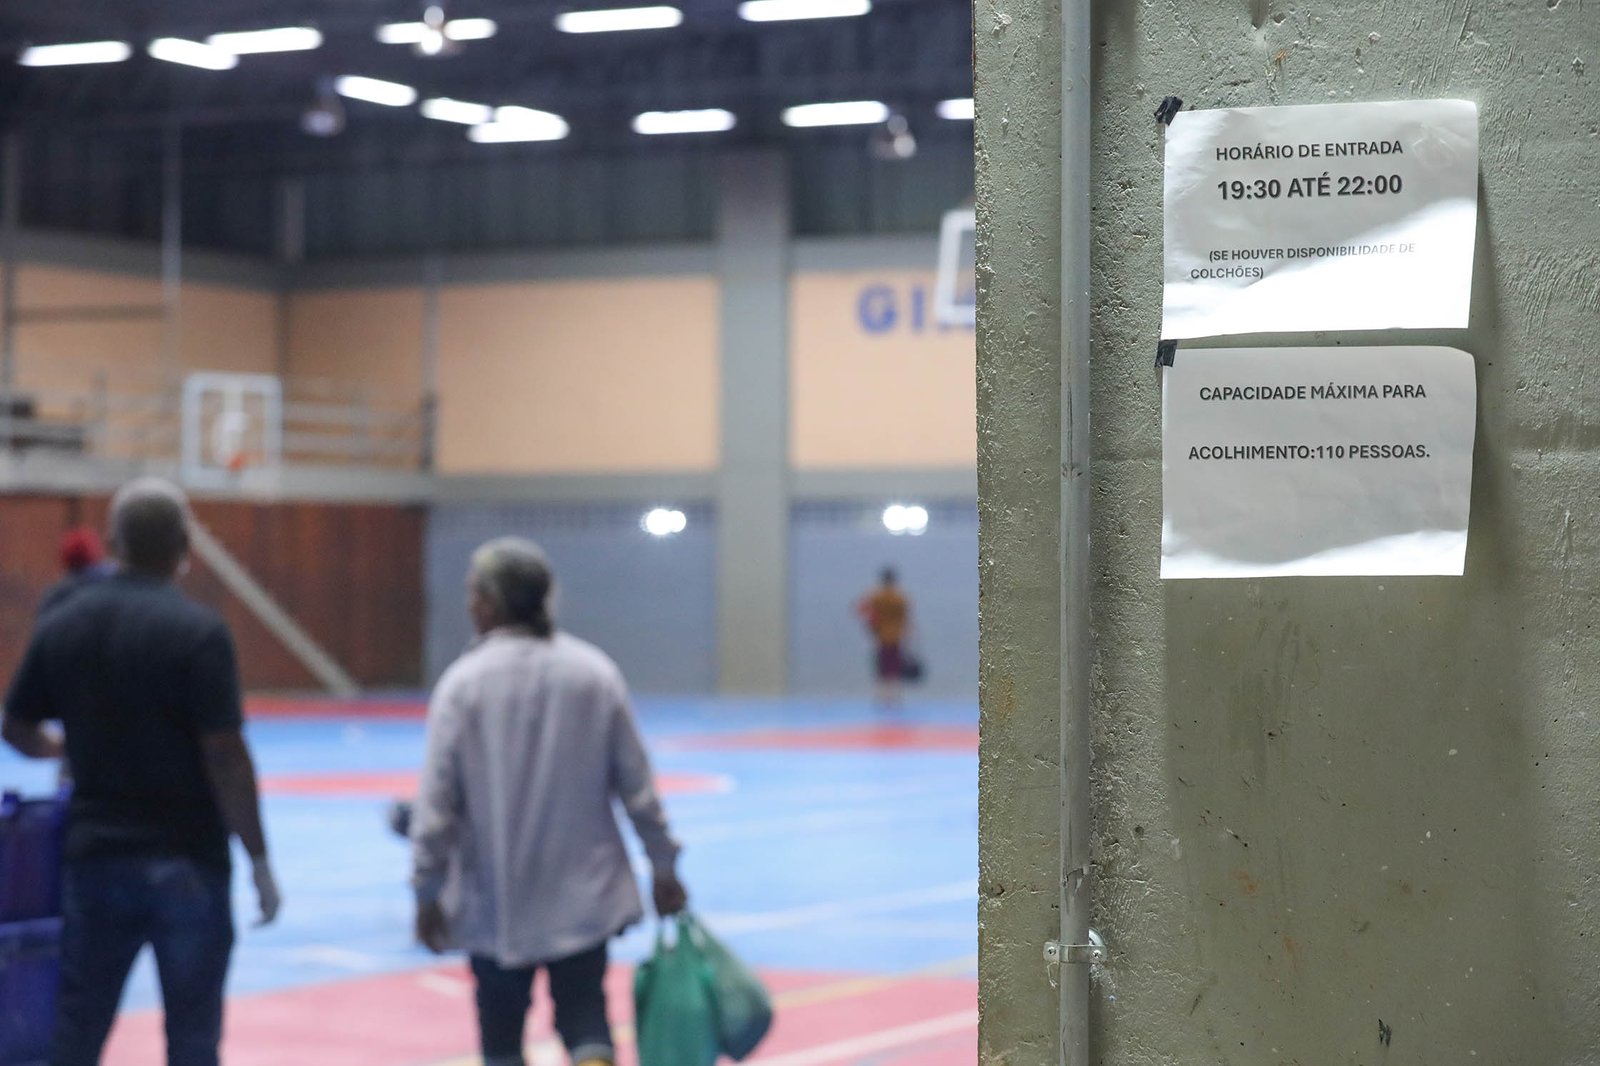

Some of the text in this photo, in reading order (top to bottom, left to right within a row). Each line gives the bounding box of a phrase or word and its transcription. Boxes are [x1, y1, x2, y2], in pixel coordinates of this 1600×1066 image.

[1216, 140, 1403, 160] HORÁRIO DE ENTRADA
[1217, 172, 1402, 200] 19:30 ATÉ 22:00
[1209, 243, 1415, 263] (SE HOUVER DISPONIBILIDADE DE
[1190, 266, 1264, 280] COLCHÕES)
[856, 281, 975, 335] GI
[1199, 382, 1426, 401] CAPACIDADE MÁXIMA PARA
[1349, 444, 1431, 459] PESSOAS.
